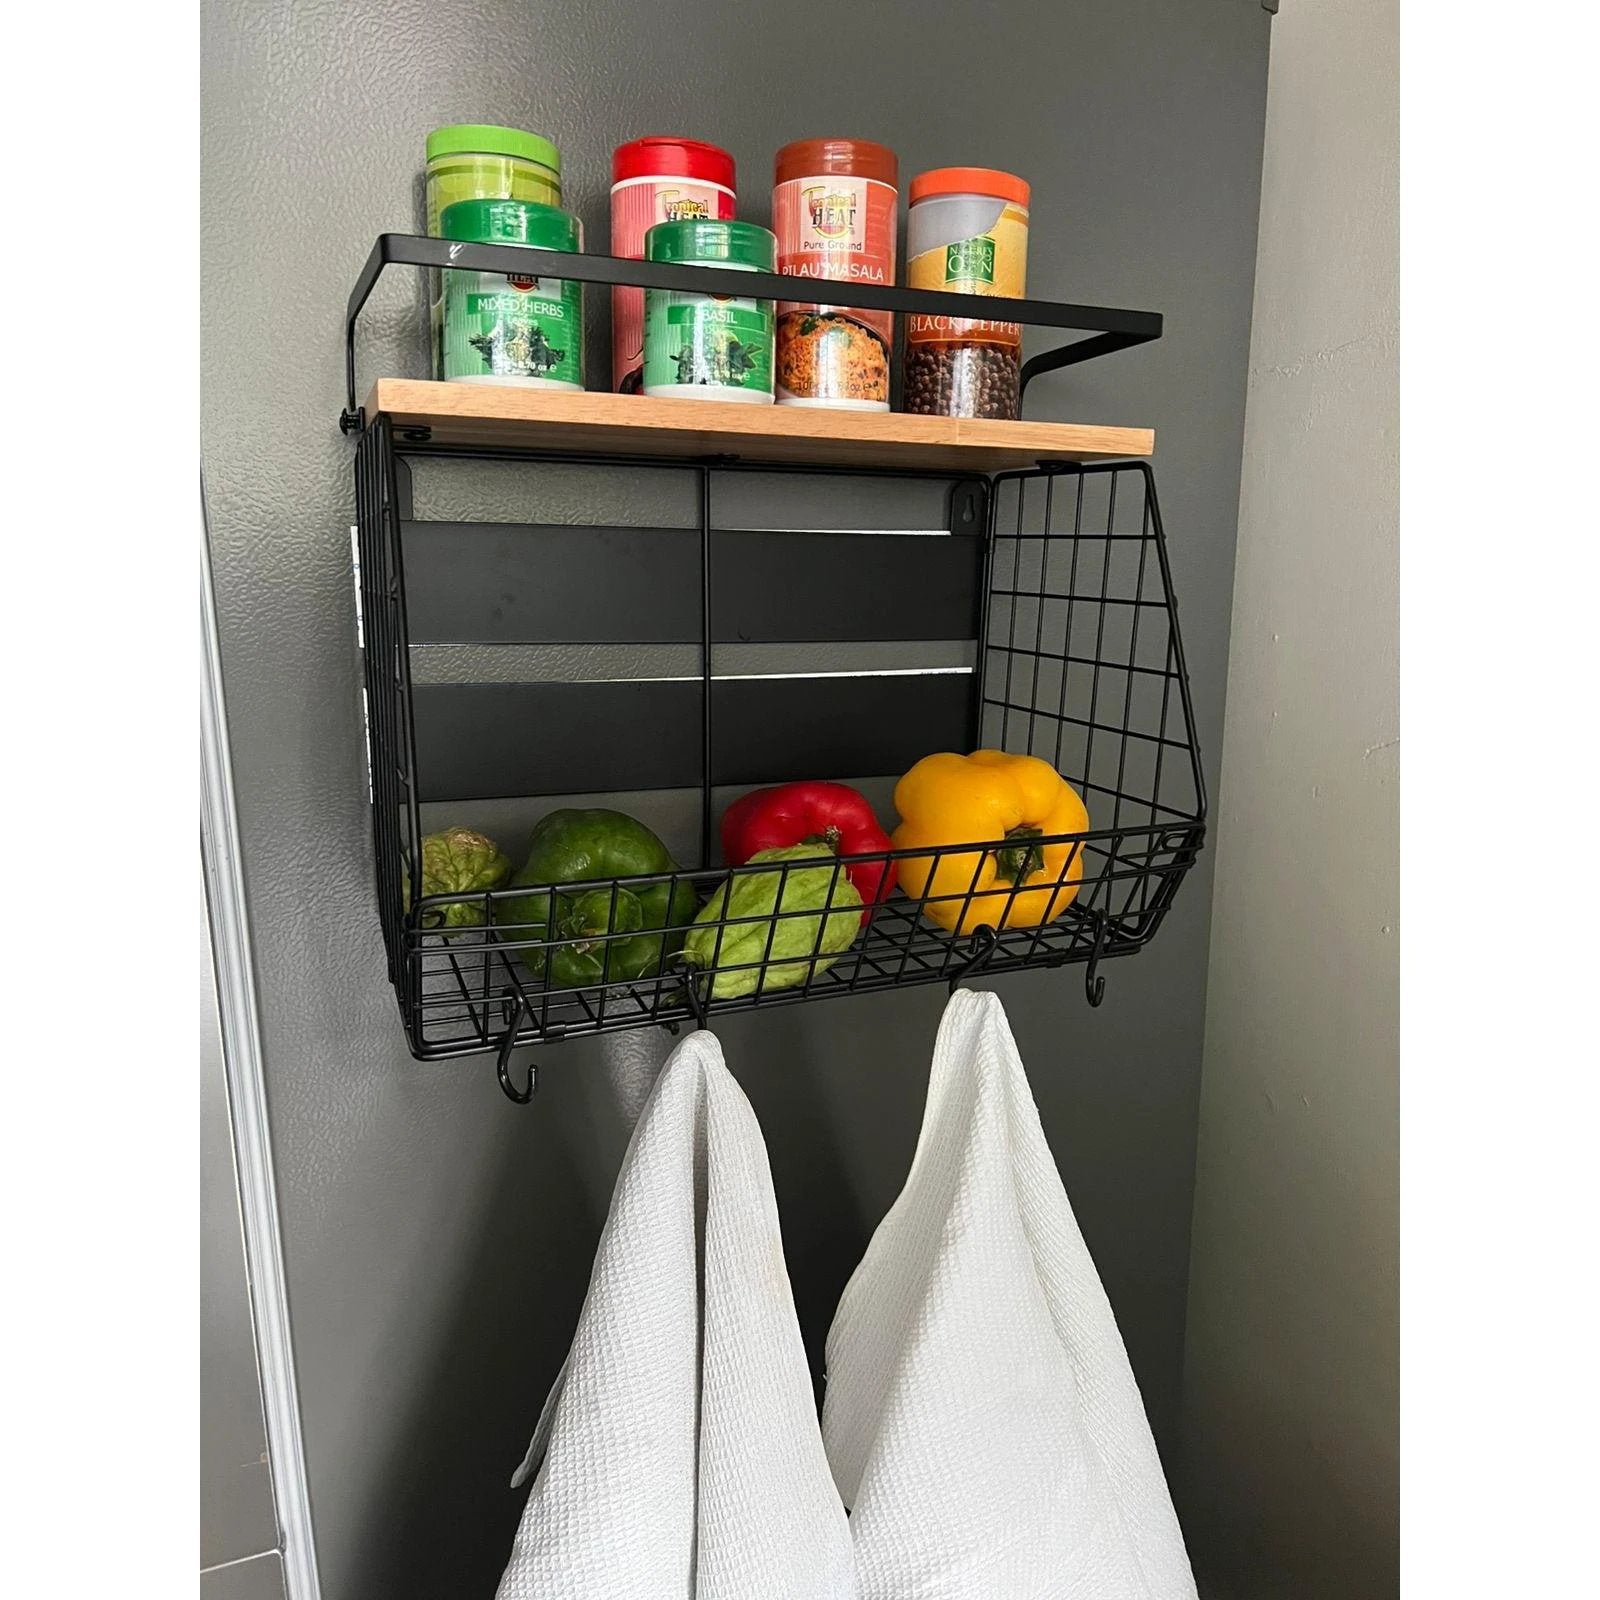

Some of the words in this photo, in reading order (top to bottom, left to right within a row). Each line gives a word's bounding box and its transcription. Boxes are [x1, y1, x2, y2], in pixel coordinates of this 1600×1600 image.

[812, 207, 856, 226] HEAT
[803, 240, 825, 251] Pure
[828, 239, 862, 251] Grond
[782, 263, 820, 277] PILAU
[826, 262, 884, 281] MASALA
[477, 297, 521, 313] MIXED
[523, 299, 565, 319] HERBS
[703, 308, 738, 324] BASIL
[909, 315, 958, 334] BLACK
